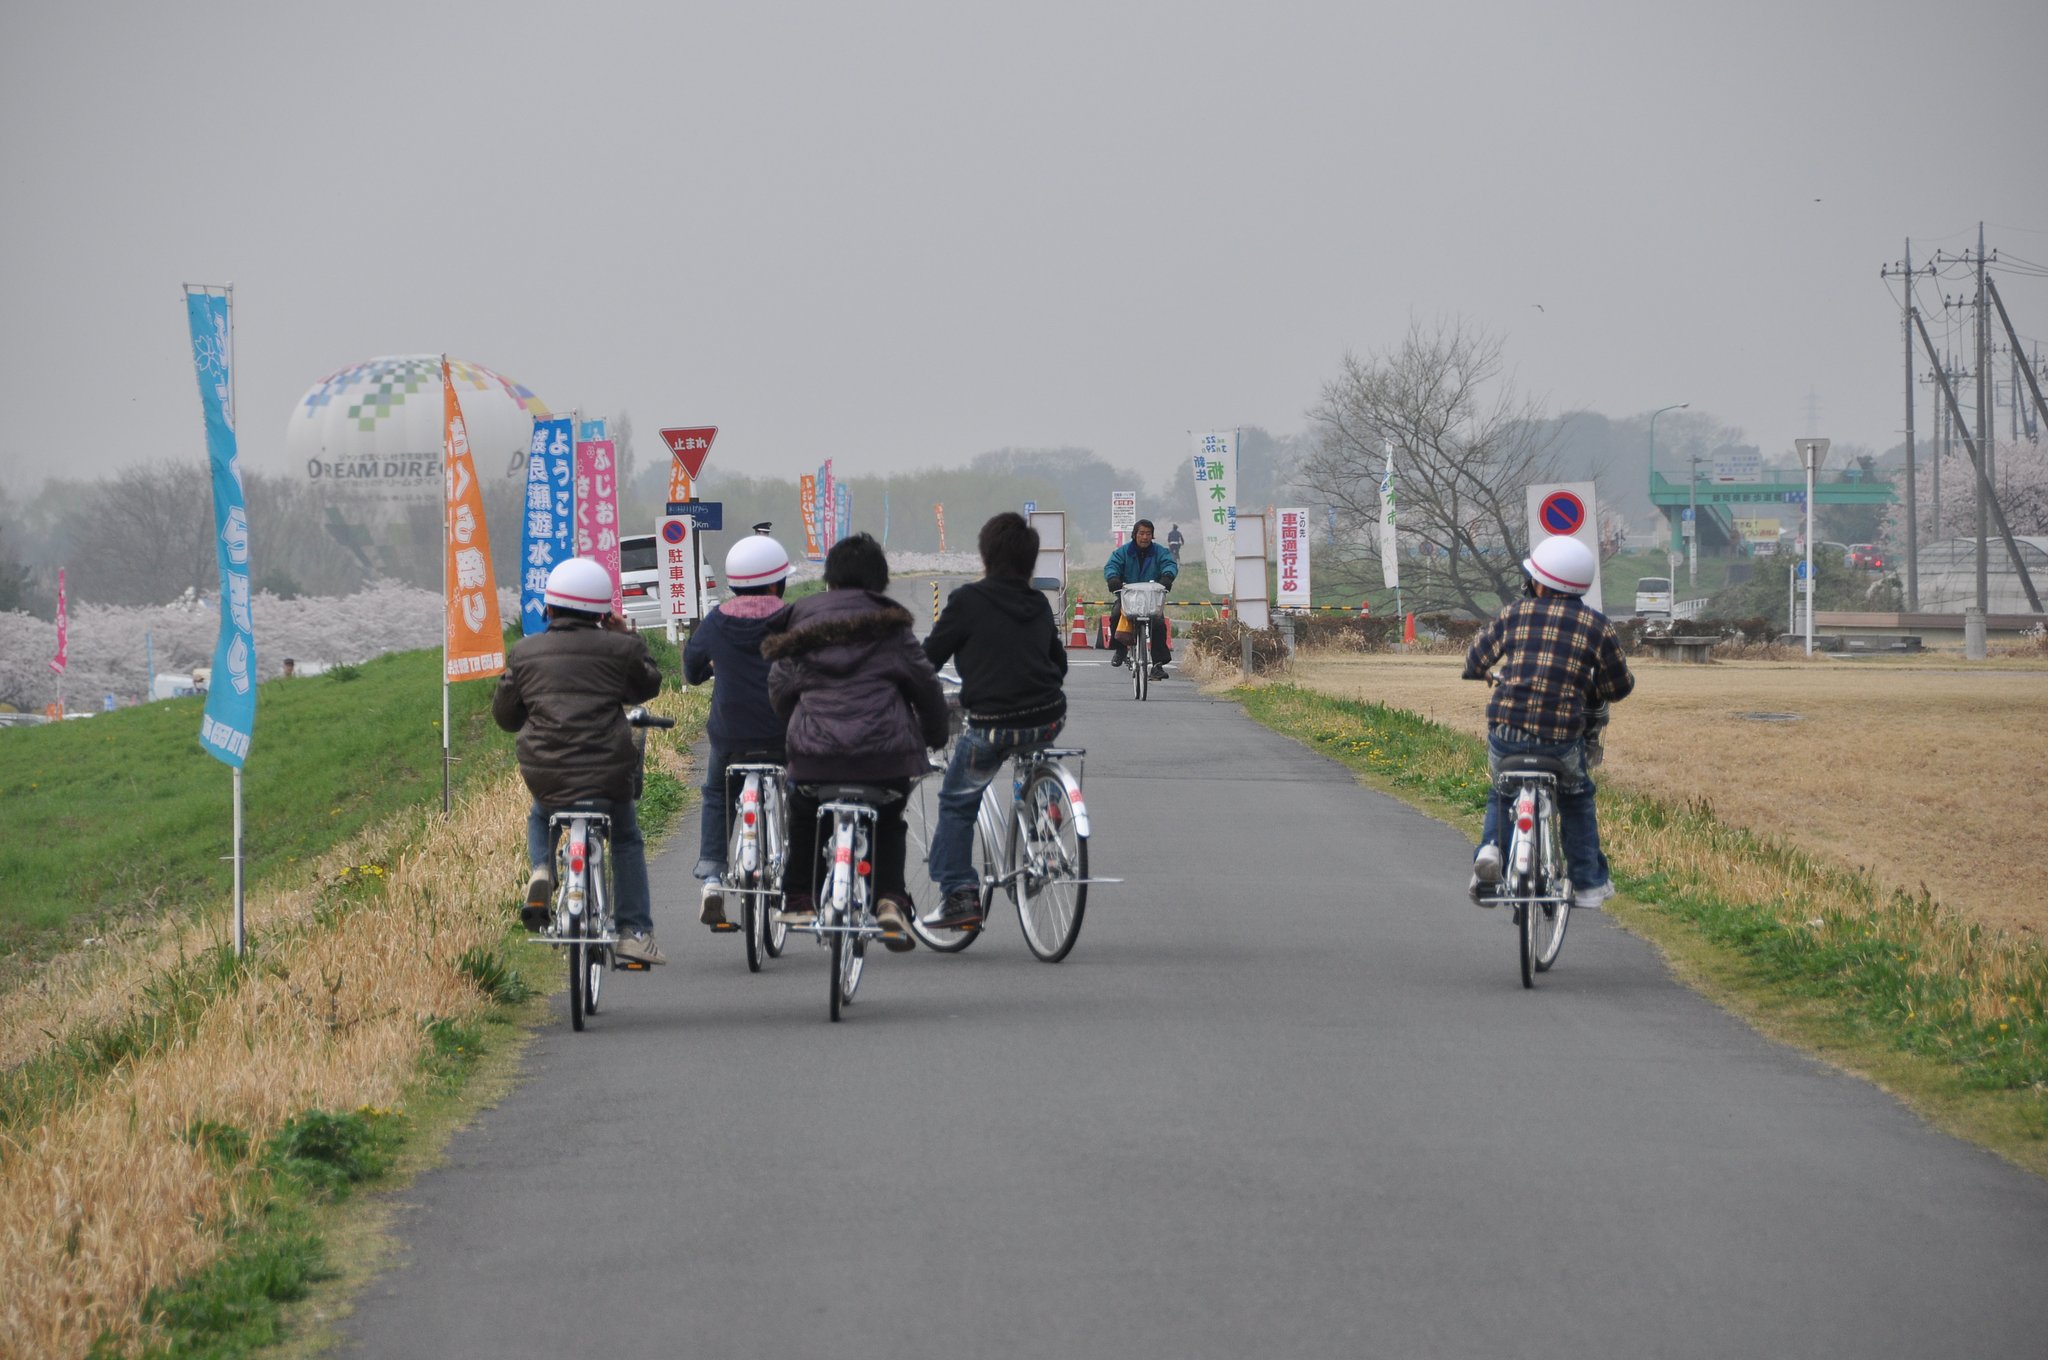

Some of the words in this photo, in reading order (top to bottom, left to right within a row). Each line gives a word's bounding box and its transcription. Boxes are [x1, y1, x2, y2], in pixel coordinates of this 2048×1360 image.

[308, 457, 378, 479] DREAM
[383, 460, 443, 478] DIRE
[674, 437, 707, 450] 止まれ
[577, 475, 595, 560] さくら
[593, 448, 617, 551] ふじおか
[668, 549, 687, 615] 駐車禁止
[1282, 513, 1297, 592] 車両通行止め
